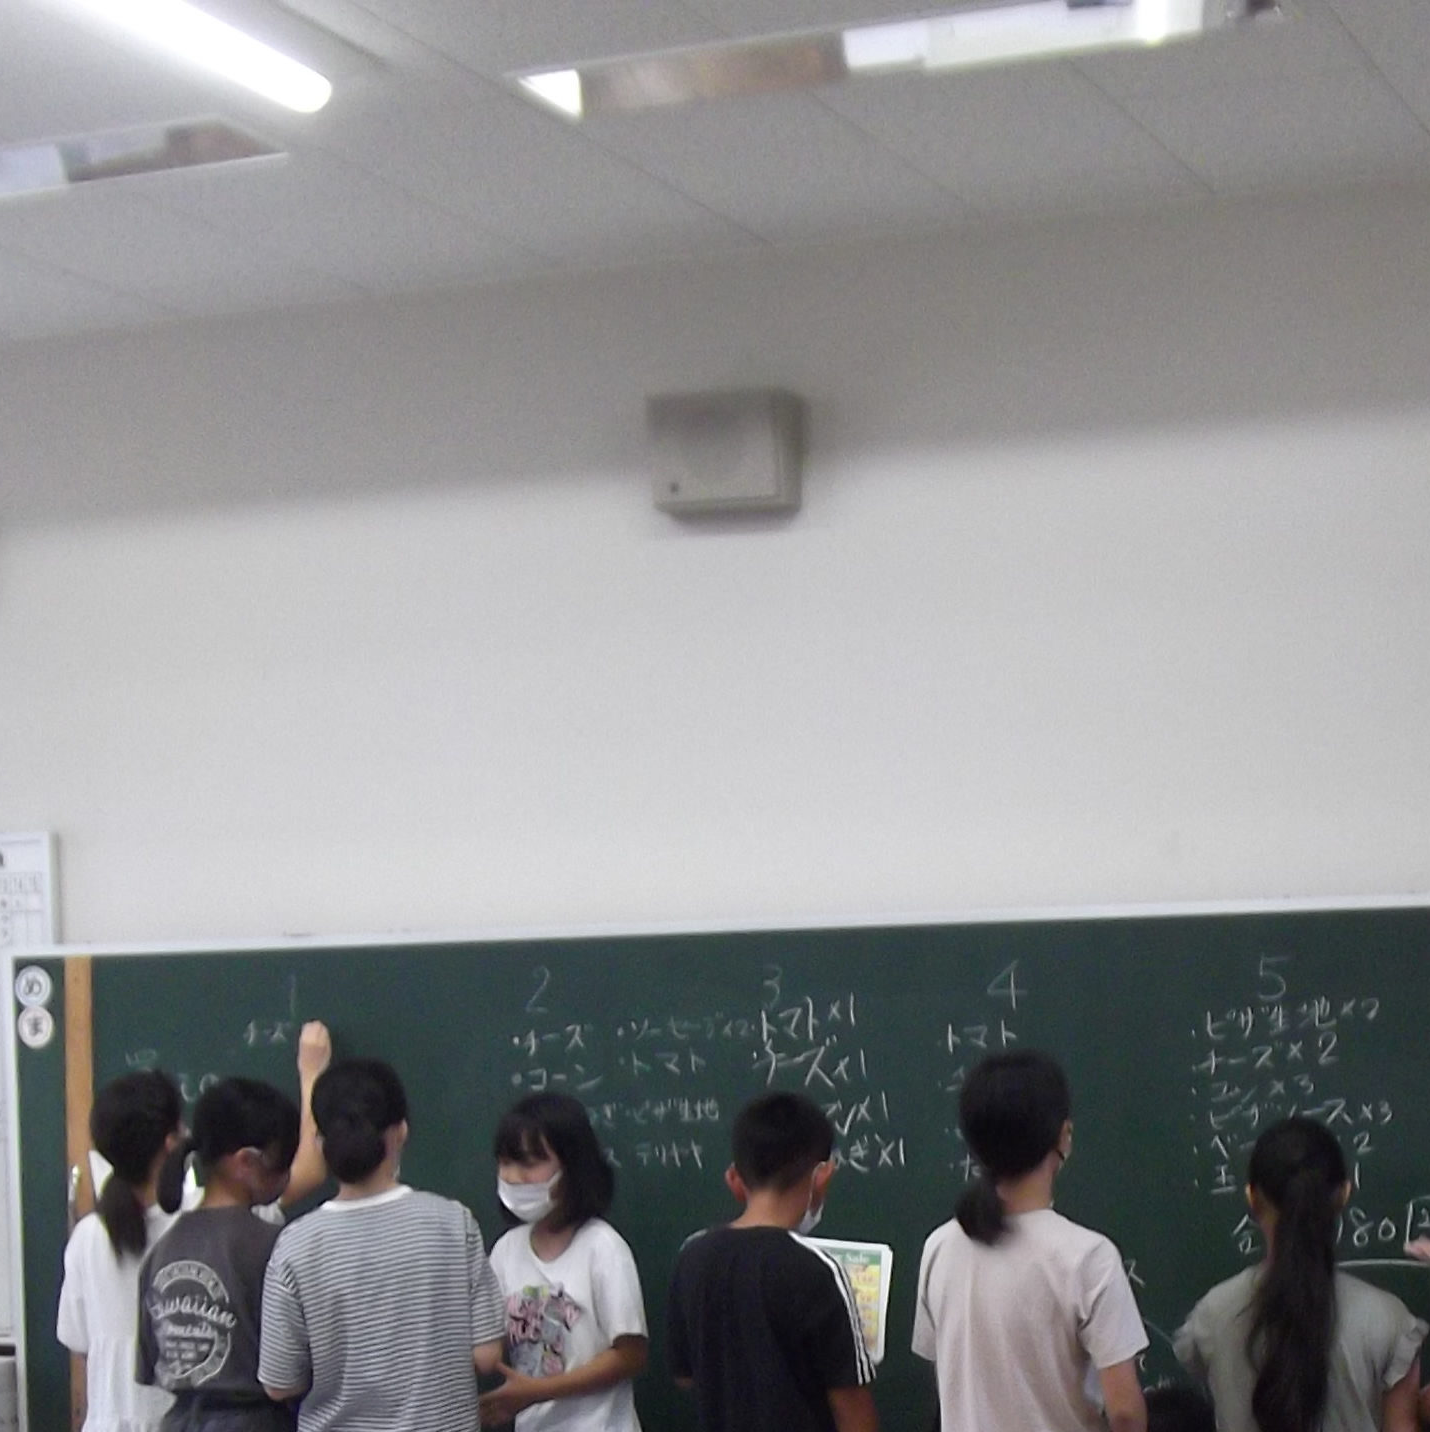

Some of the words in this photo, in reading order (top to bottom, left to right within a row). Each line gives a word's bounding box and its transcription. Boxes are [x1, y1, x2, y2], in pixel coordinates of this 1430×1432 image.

[525, 965, 550, 1014] 2
[986, 960, 1028, 1011] 4
[1258, 954, 1288, 1001] 5
